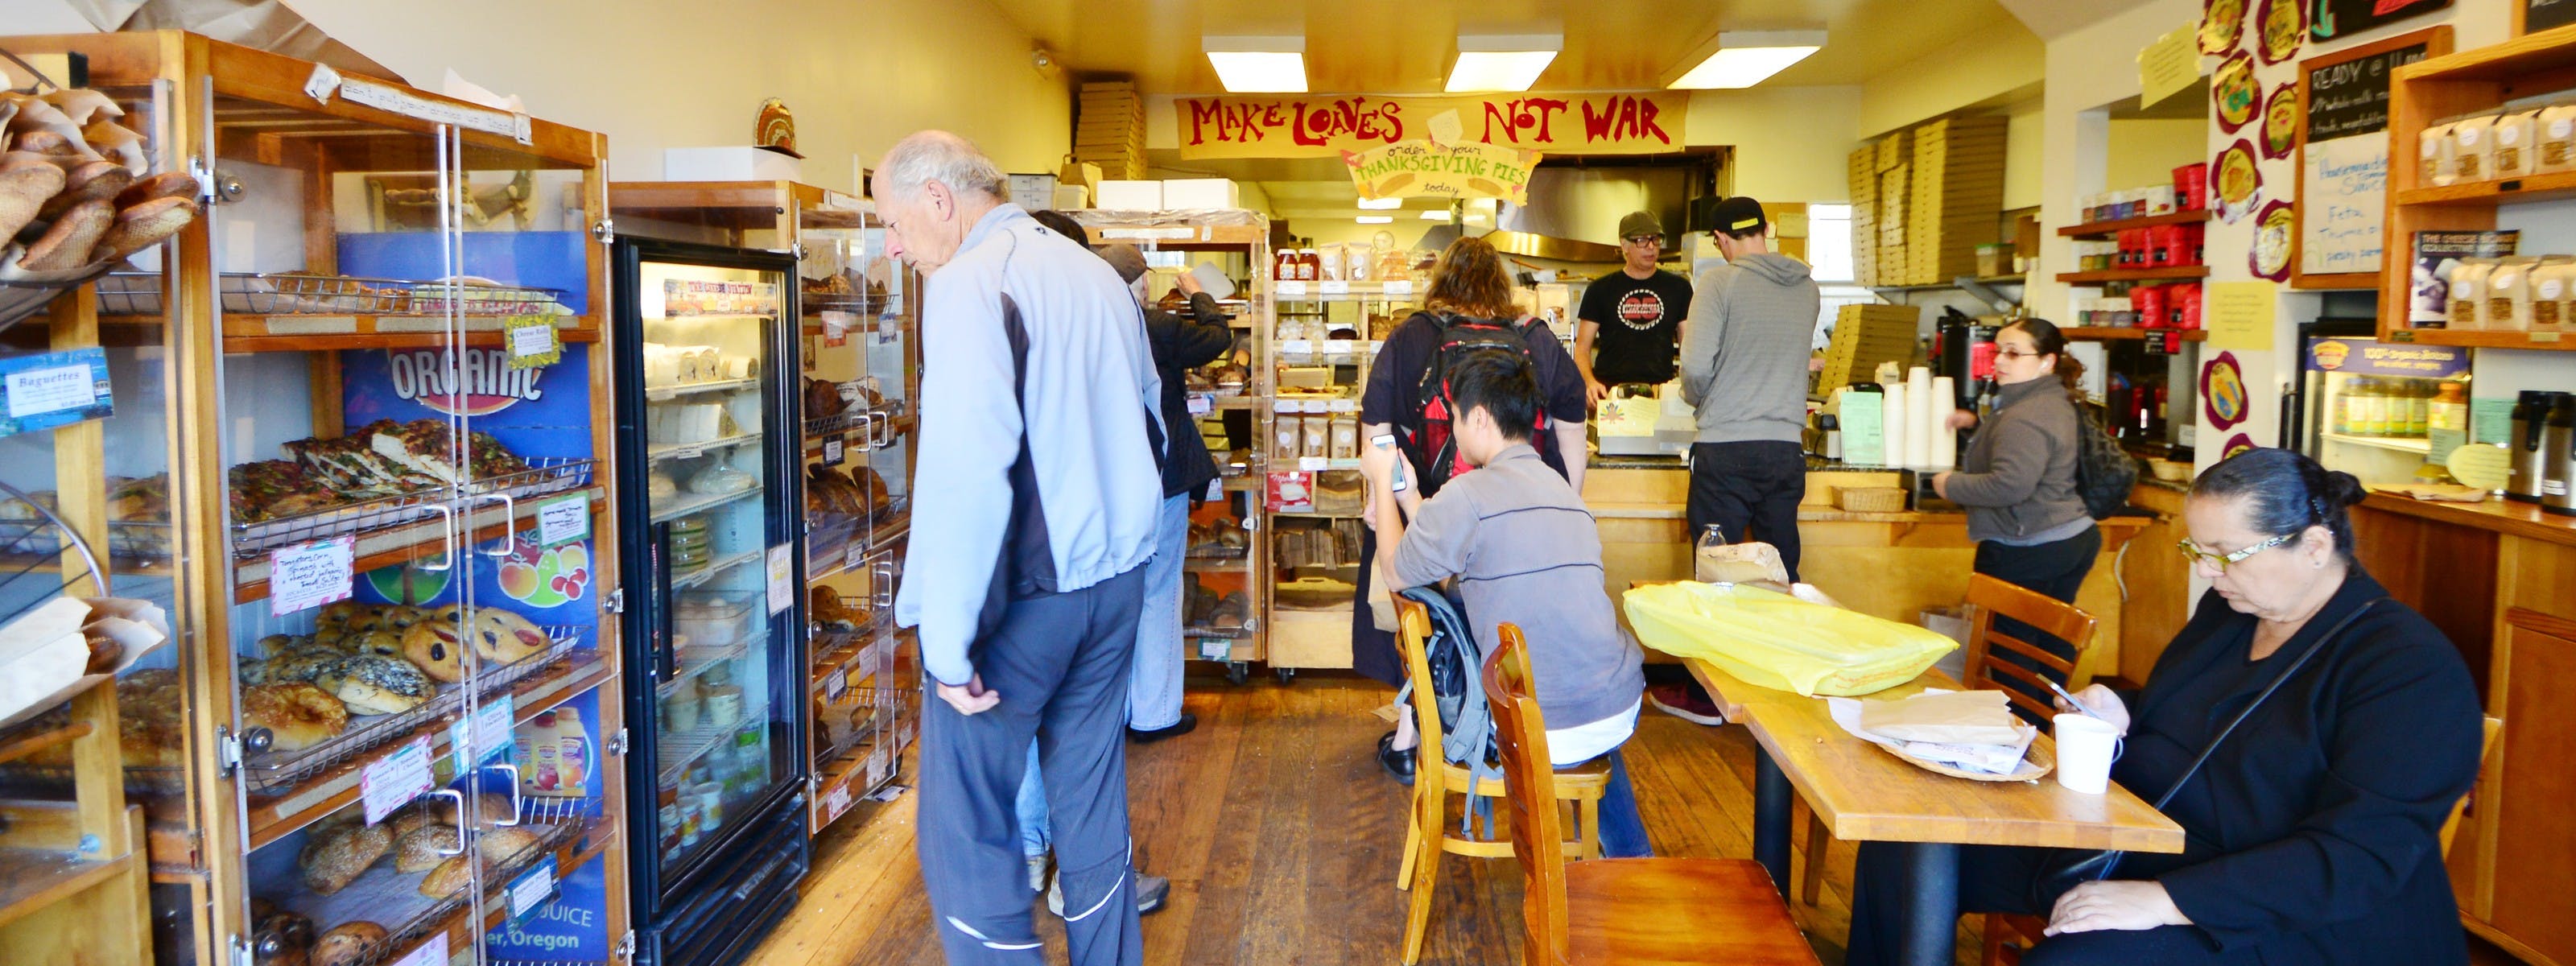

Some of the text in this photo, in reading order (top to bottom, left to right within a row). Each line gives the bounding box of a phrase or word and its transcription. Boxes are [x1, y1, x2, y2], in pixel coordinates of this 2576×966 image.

[2312, 60, 2366, 90] READY
[2369, 59, 2384, 76] @
[1188, 95, 1671, 147] MAKE LOAVES NOT WAR
[1387, 143, 1482, 161] order your
[1356, 154, 1526, 186] THANKSGIVING PIES
[1422, 182, 1461, 196] today
[19, 370, 81, 388] Baguettes
[391, 348, 543, 402] ORGANIC
[485, 929, 580, 951] er, Oregon
